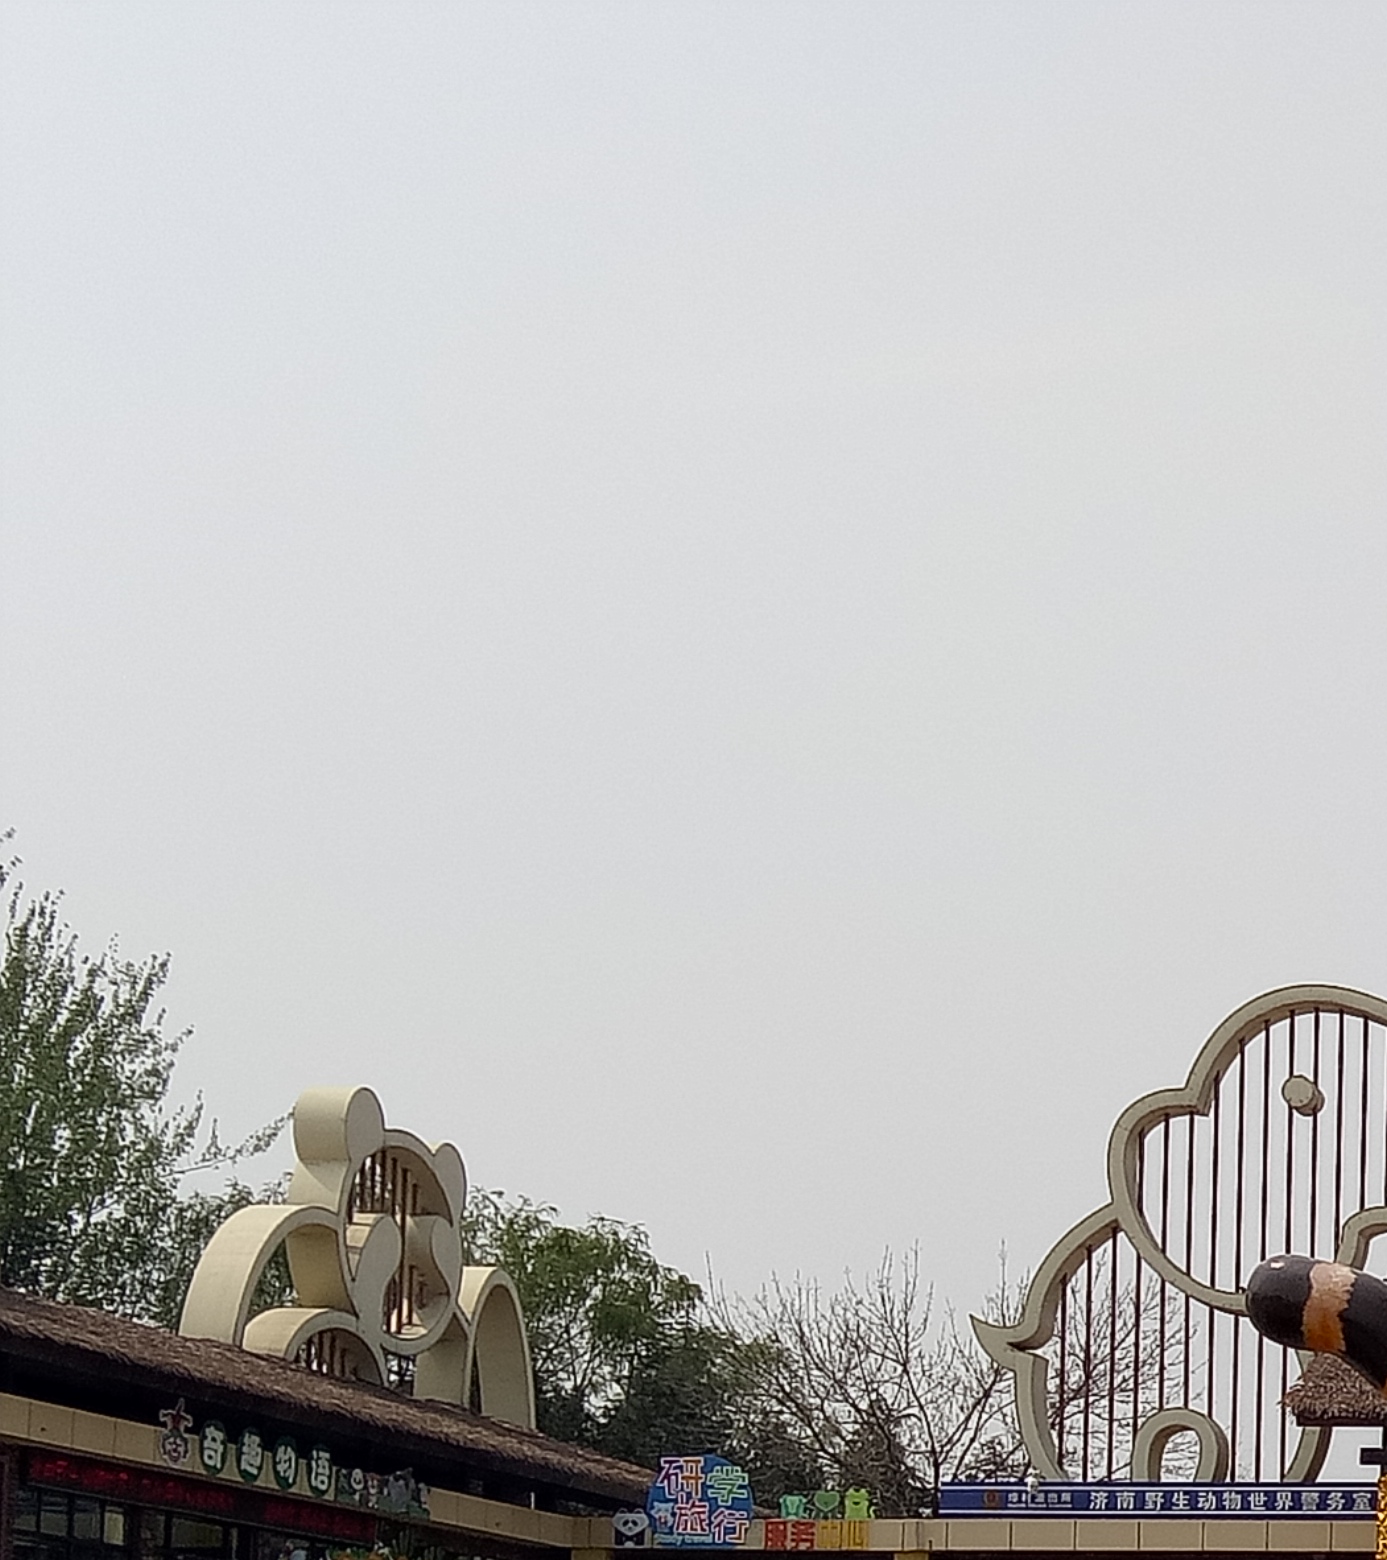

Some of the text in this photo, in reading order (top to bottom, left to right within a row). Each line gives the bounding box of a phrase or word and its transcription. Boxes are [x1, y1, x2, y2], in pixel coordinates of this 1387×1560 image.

[202, 1425, 332, 1491] 奇趣物语
[656, 1456, 749, 1506] 研学
[674, 1493, 749, 1544] 旅行
[1089, 1491, 1373, 1512] 济南野生动物世界警务室
[764, 1520, 868, 1550] 服务中心
